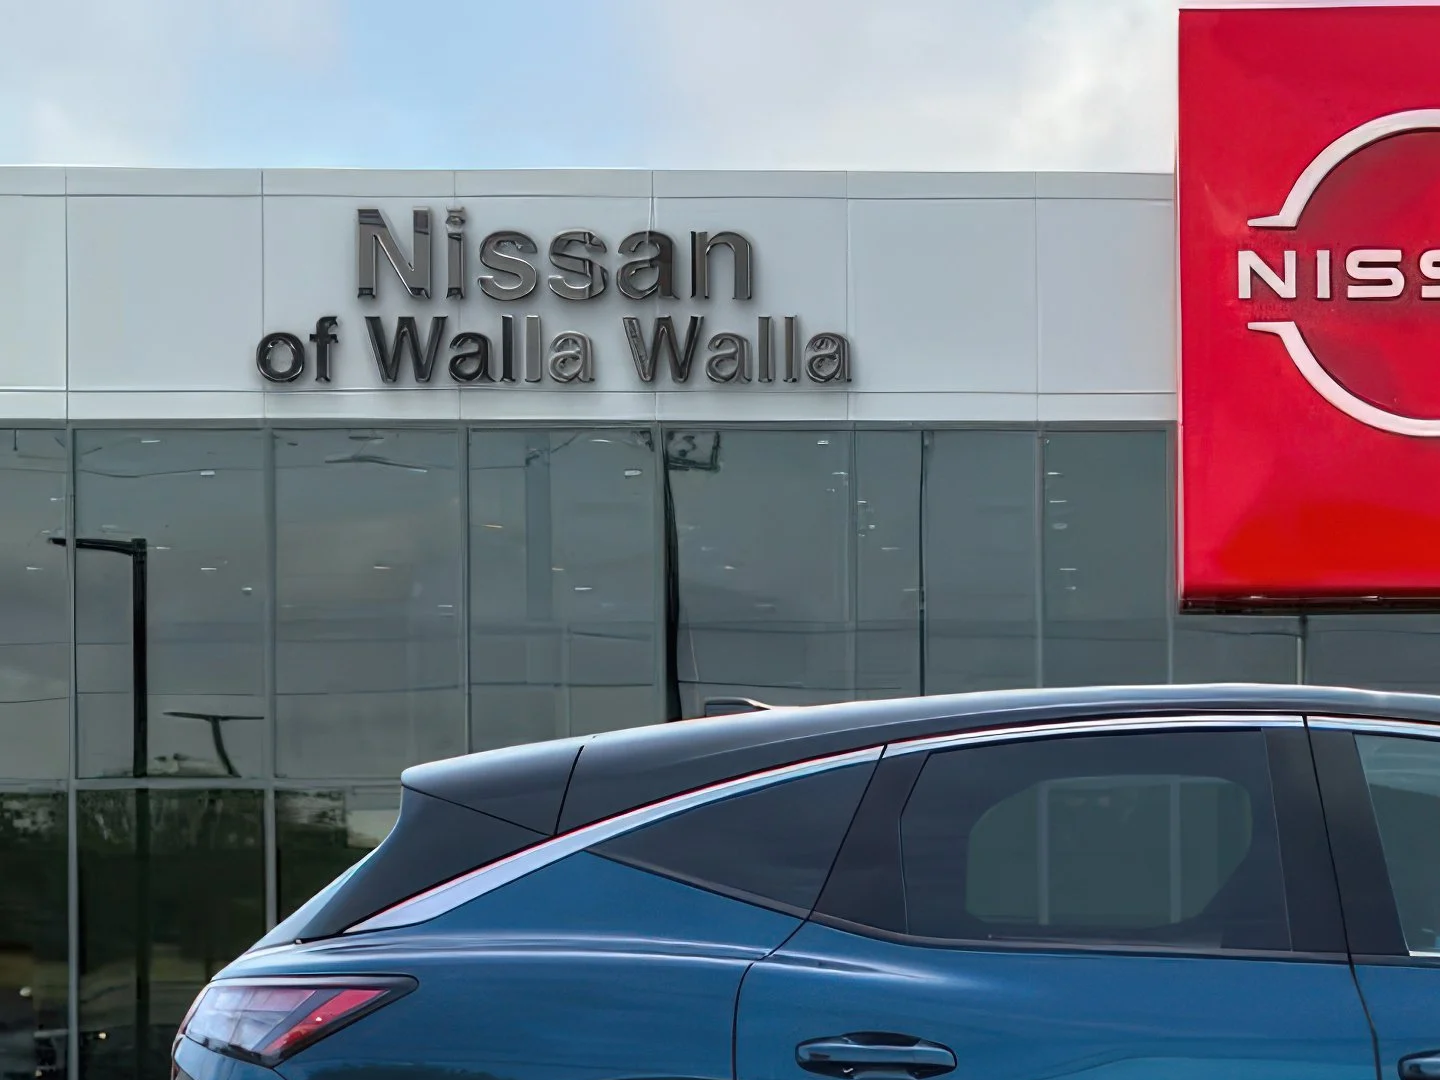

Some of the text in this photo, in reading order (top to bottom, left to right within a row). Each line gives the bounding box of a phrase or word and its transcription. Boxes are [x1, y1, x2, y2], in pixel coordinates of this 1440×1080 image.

[356, 206, 755, 300] Nissan
[257, 315, 853, 383] of Walla Walla
